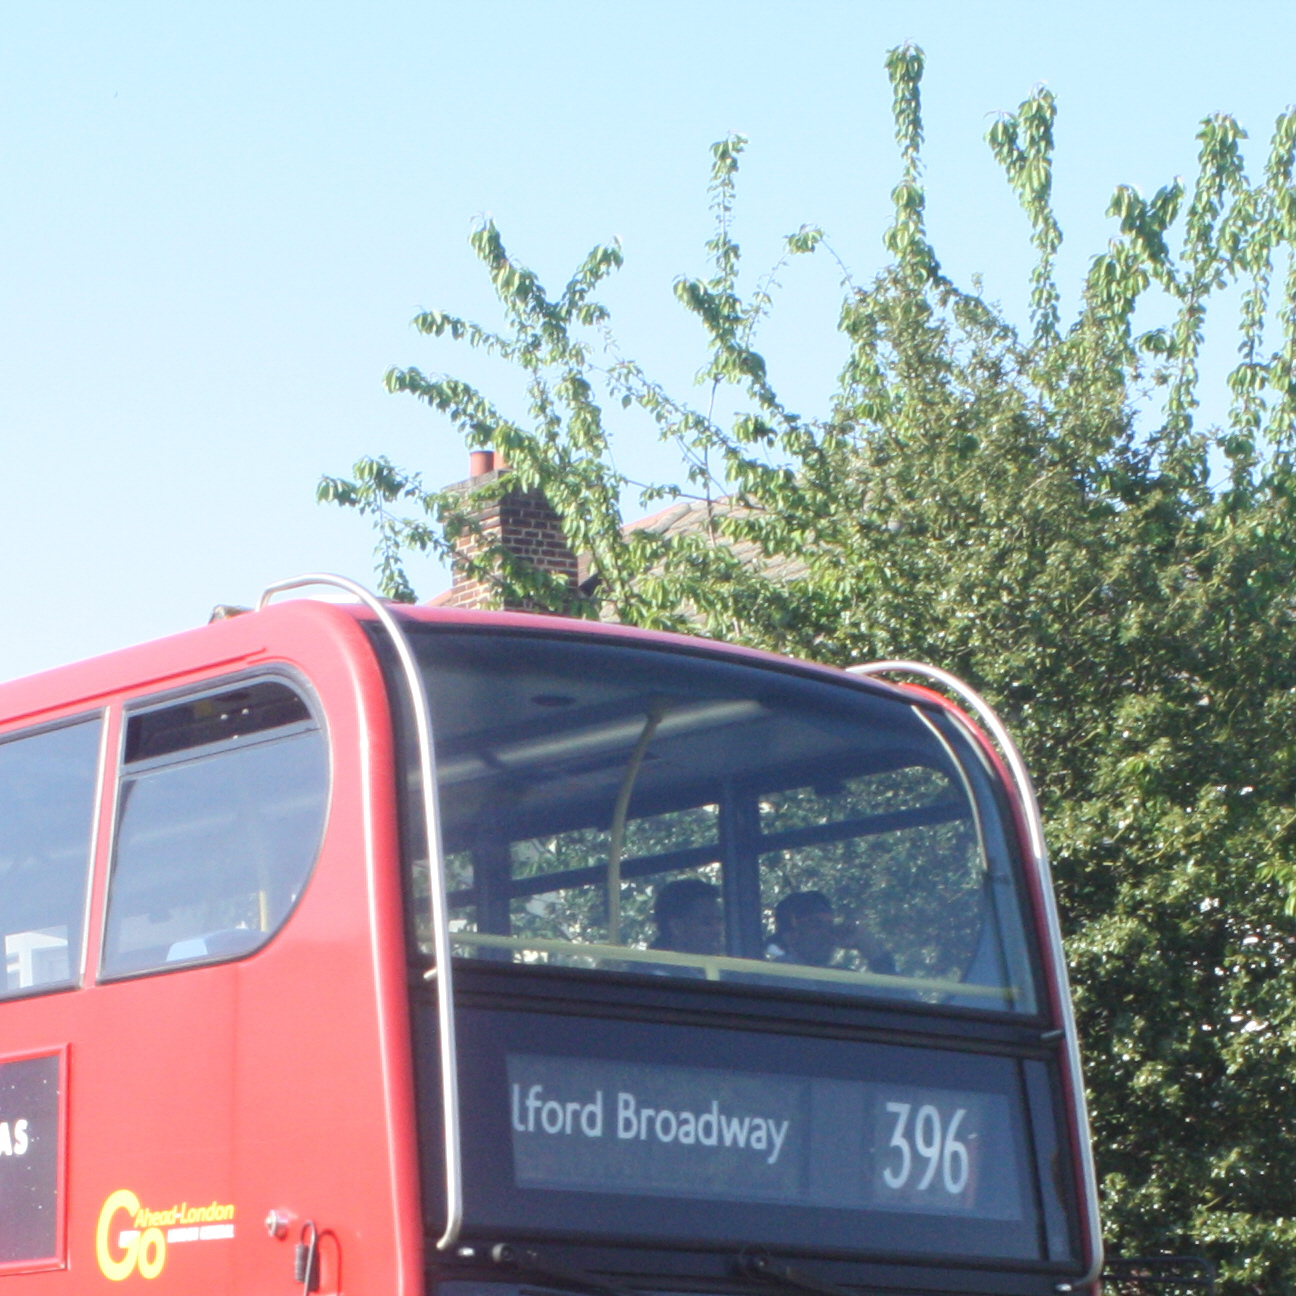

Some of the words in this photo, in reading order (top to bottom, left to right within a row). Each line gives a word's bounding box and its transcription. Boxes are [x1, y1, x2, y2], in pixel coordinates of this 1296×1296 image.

[617, 1092, 789, 1165] Broadway
[883, 1101, 969, 1194] 396
[96, 1189, 166, 1281] Go
